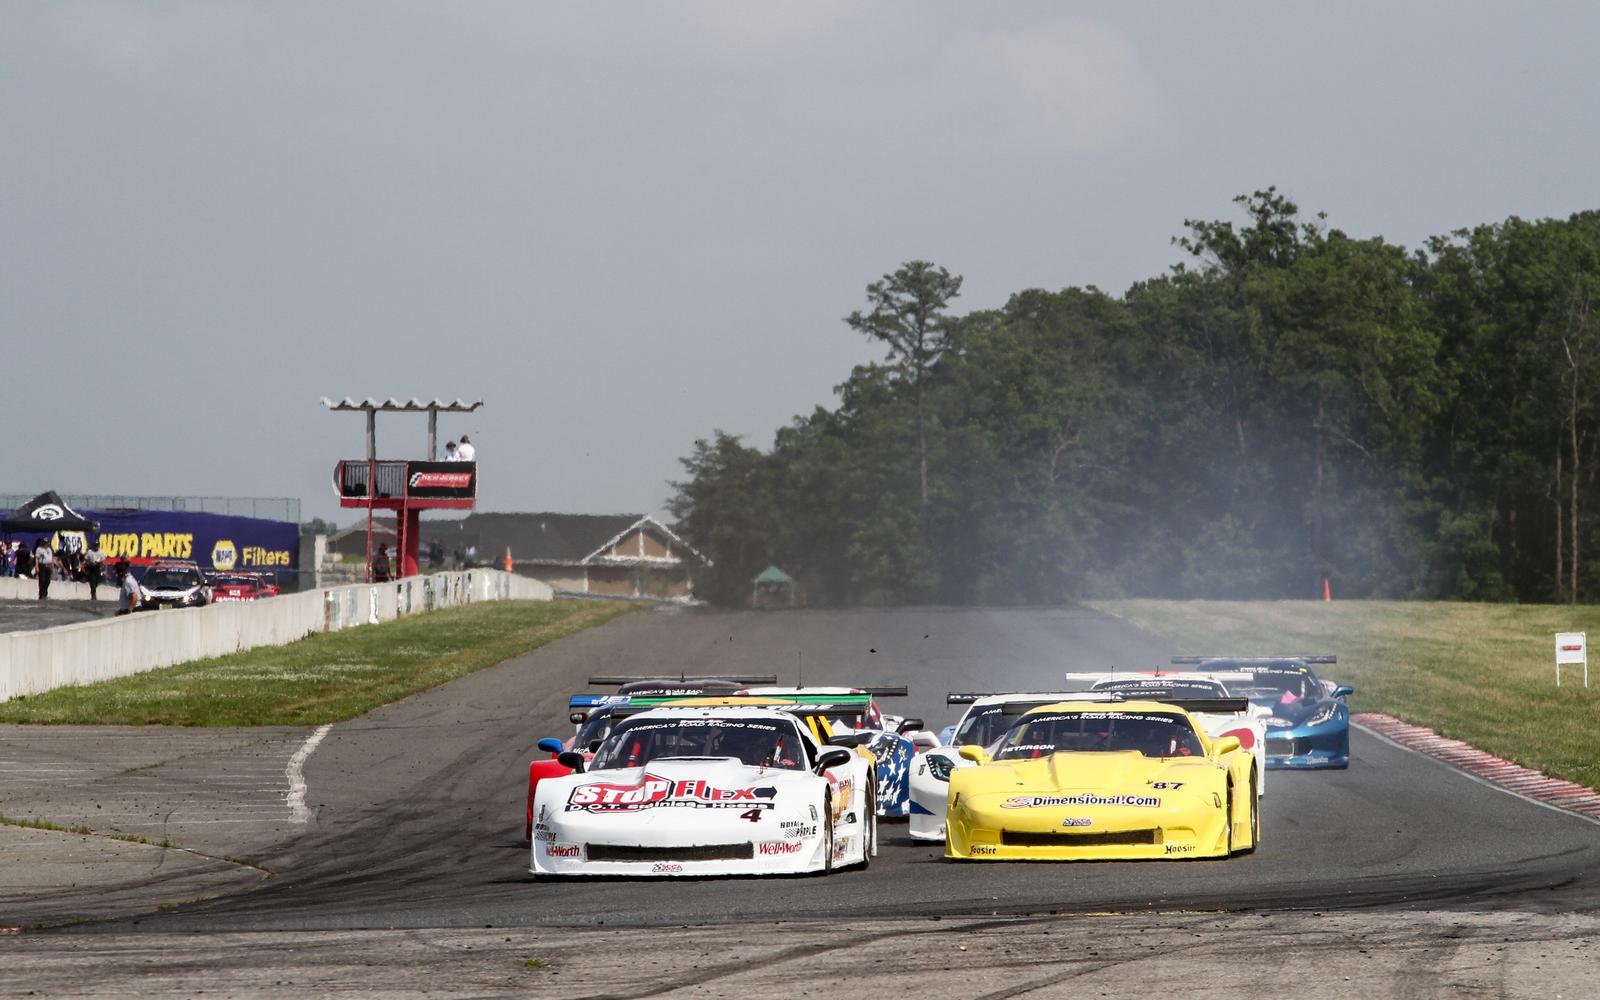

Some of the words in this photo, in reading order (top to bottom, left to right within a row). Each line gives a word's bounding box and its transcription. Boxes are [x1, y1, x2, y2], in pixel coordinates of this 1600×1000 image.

[99, 533, 138, 558] AUTO
[141, 532, 193, 559] PARTS
[242, 546, 290, 567] Filters
[1030, 715, 1078, 724] AMERICA'S
[1145, 716, 1174, 724] SERIES
[626, 722, 677, 732] AMERICA'S
[747, 723, 777, 732] SERIES
[1001, 744, 1055, 754] PETERSON
[573, 780, 668, 803] STOP
[1152, 782, 1184, 790] 87
[740, 809, 763, 823] 4
